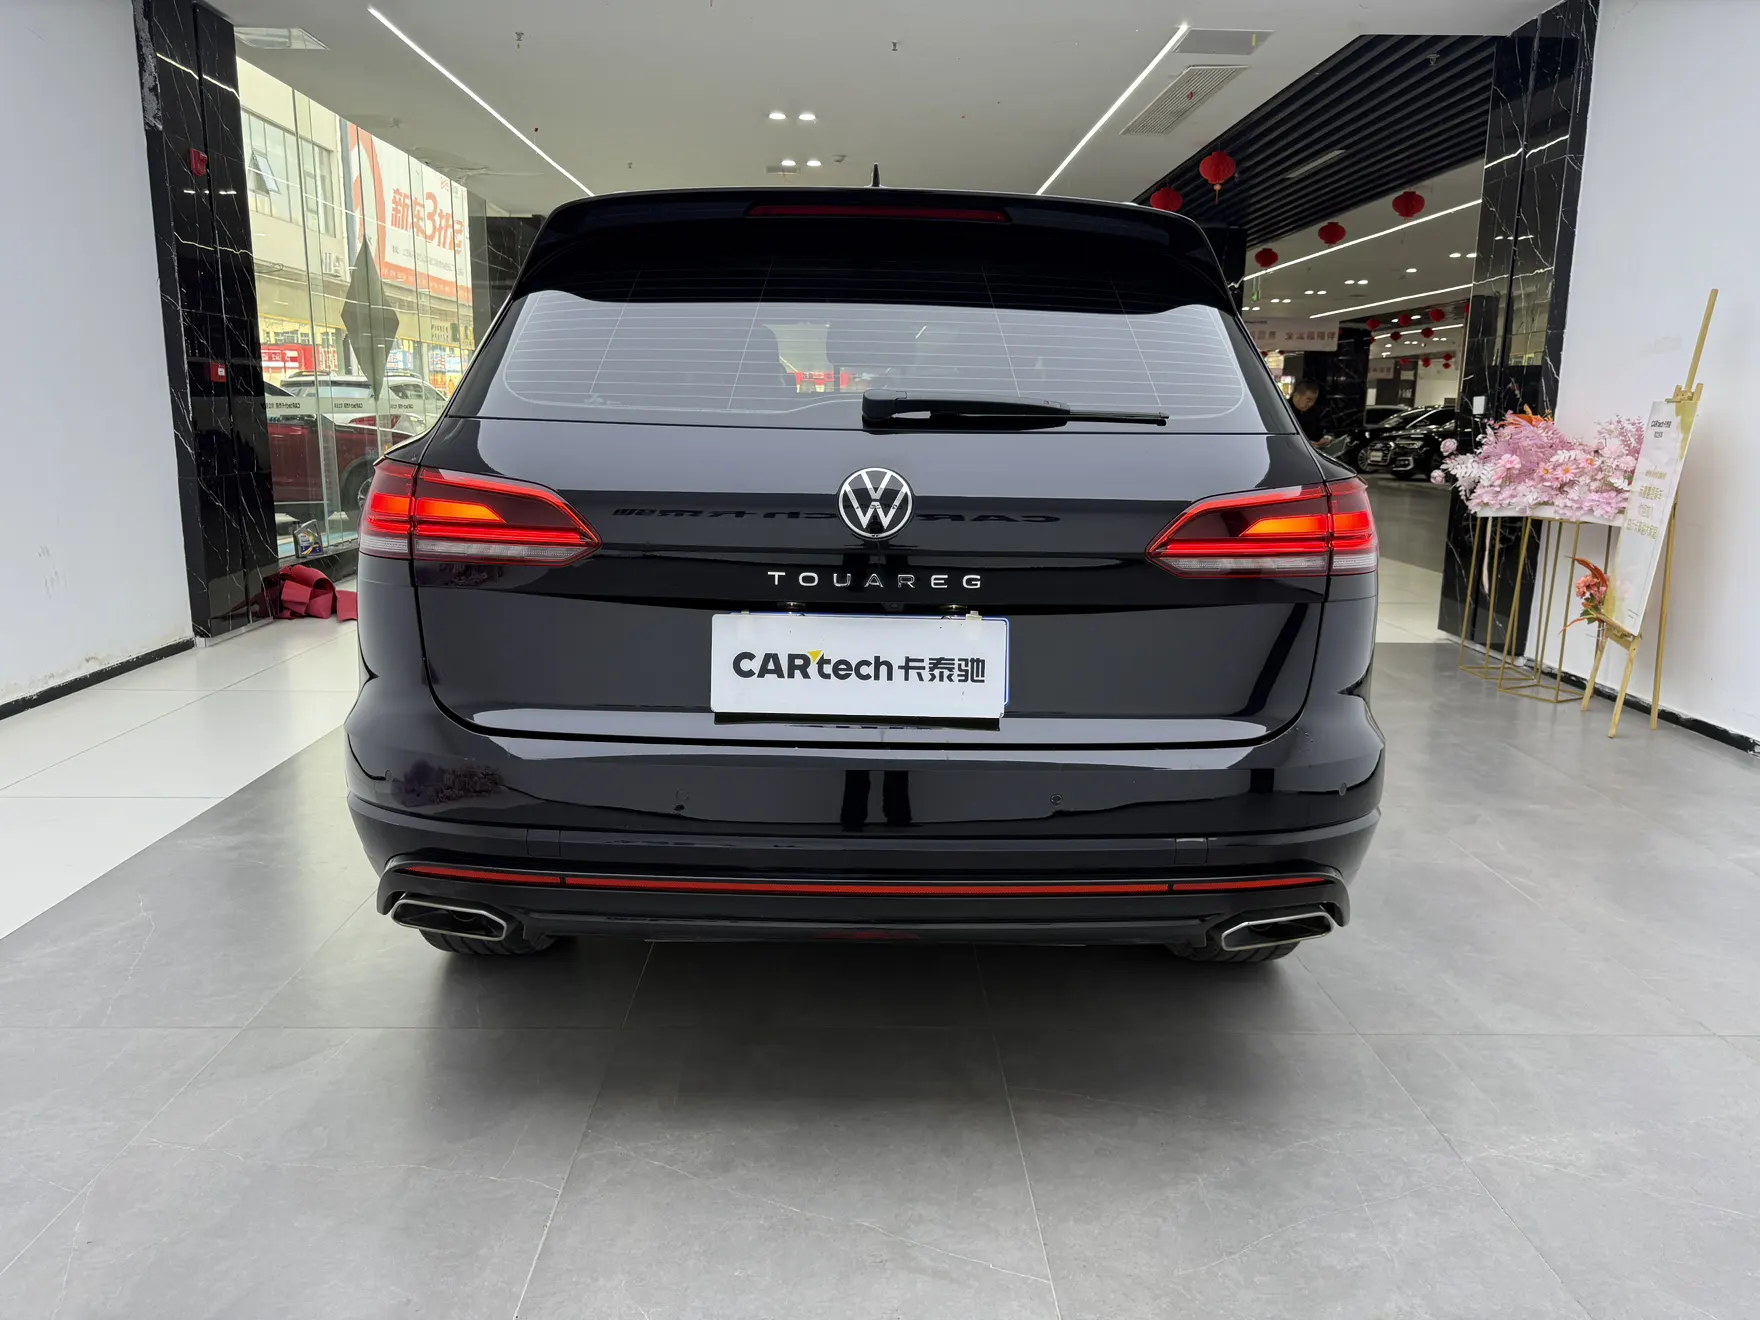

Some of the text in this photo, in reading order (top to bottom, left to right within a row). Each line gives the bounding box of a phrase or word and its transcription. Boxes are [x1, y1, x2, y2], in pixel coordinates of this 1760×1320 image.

[767, 571, 982, 589] TOUAREG
[732, 650, 987, 684] CARtech 卡泰驰
